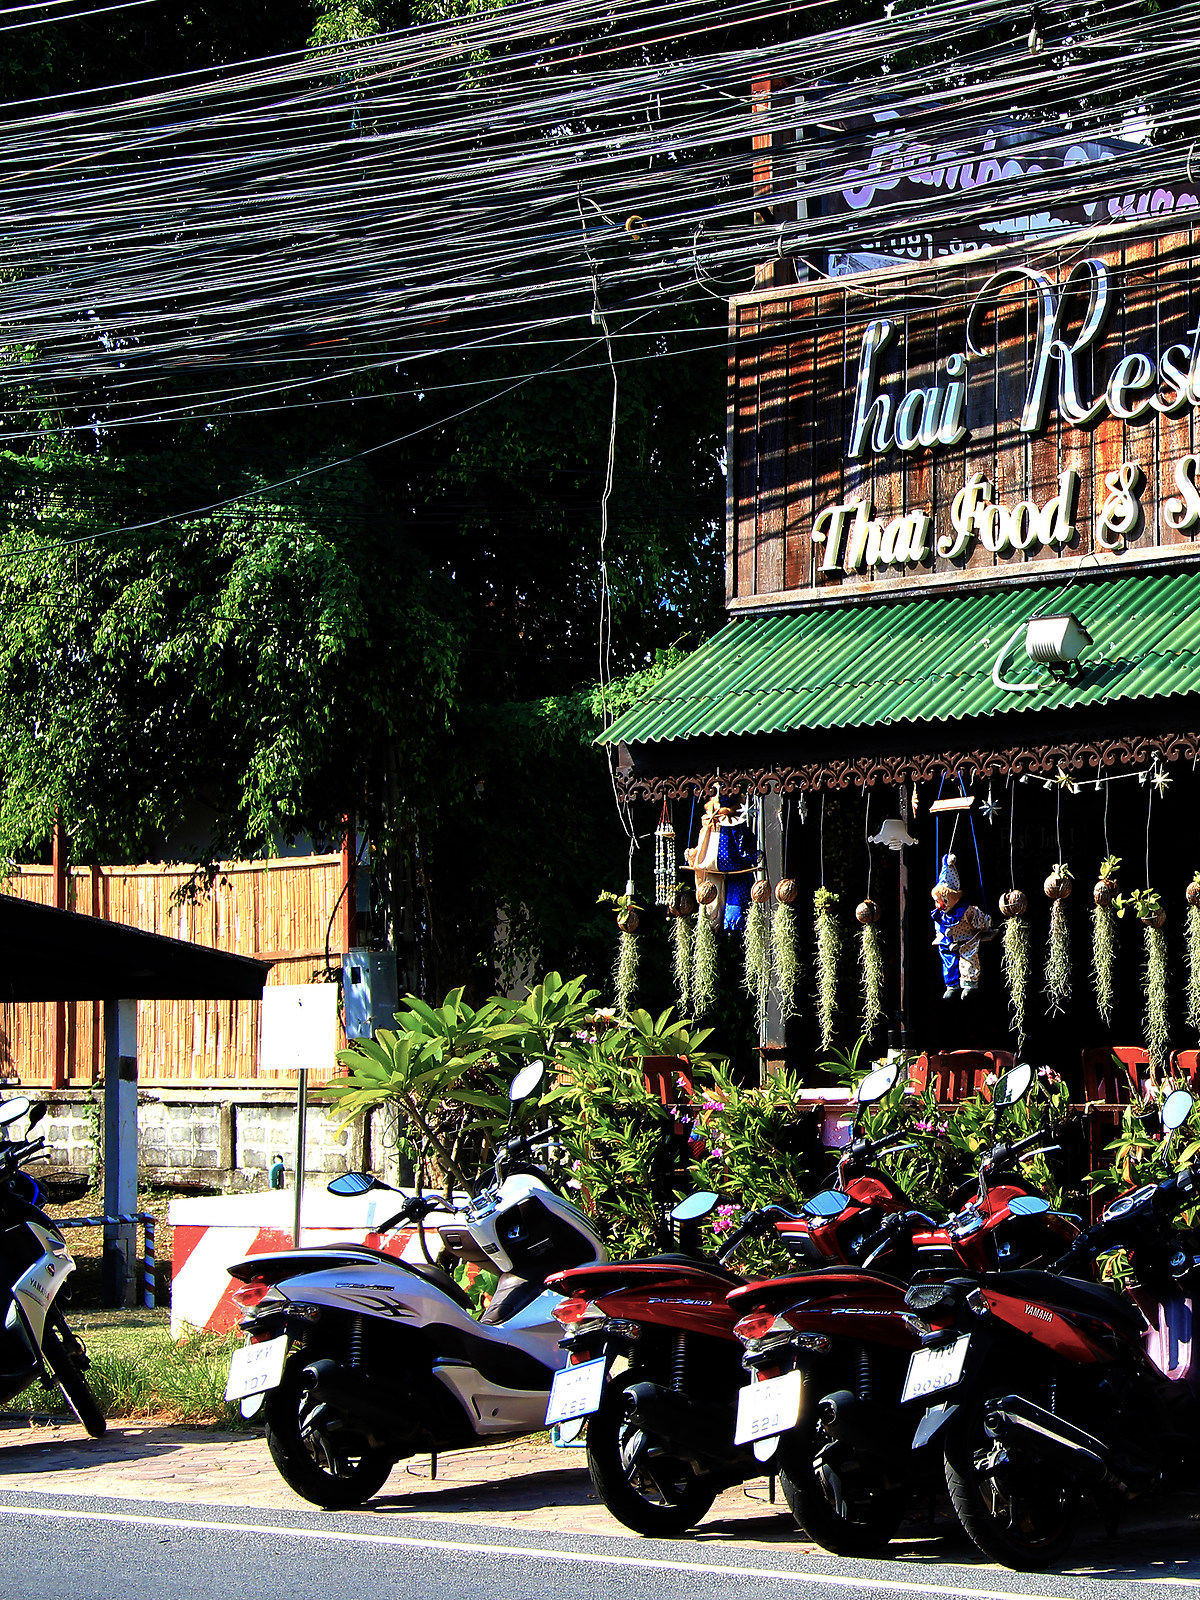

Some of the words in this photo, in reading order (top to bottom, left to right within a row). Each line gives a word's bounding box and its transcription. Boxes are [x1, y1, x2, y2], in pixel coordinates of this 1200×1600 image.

[813, 500, 932, 572] Thai
[938, 470, 1081, 559] Food
[1097, 460, 1141, 550] &
[1024, 1302, 1054, 1323] YAMAHA
